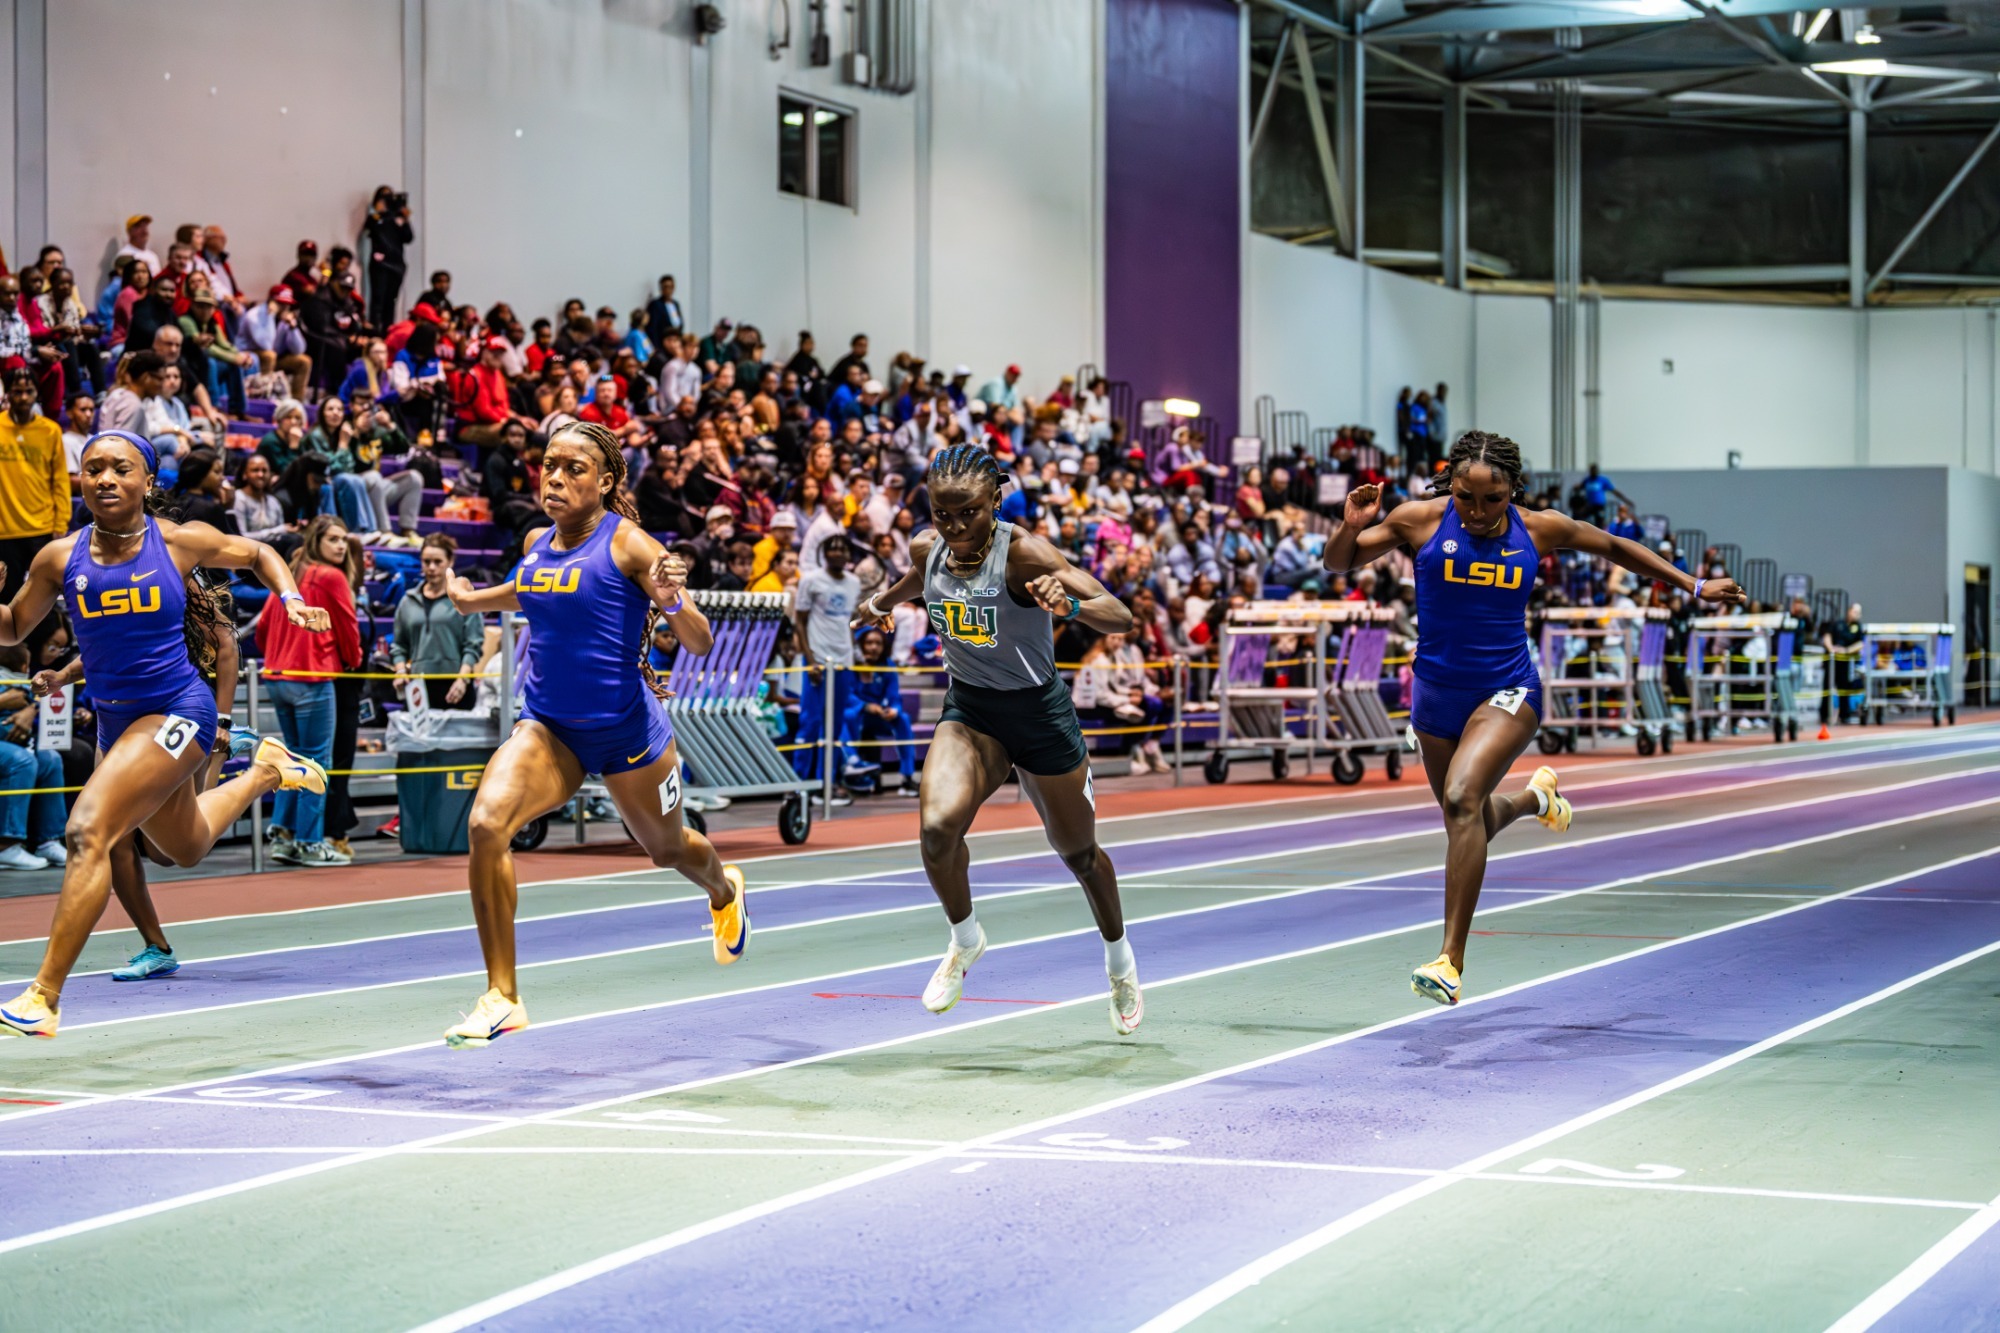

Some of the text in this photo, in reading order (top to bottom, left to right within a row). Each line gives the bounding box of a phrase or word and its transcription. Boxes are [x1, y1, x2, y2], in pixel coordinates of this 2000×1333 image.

[516, 567, 582, 593] LSU
[1444, 559, 1522, 589] LSU
[76, 586, 161, 619] LSU
[928, 600, 998, 642] SLU
[1495, 688, 1520, 707] 3
[165, 720, 193, 751] 6
[446, 772, 483, 790] LS
[665, 773, 678, 809] 5
